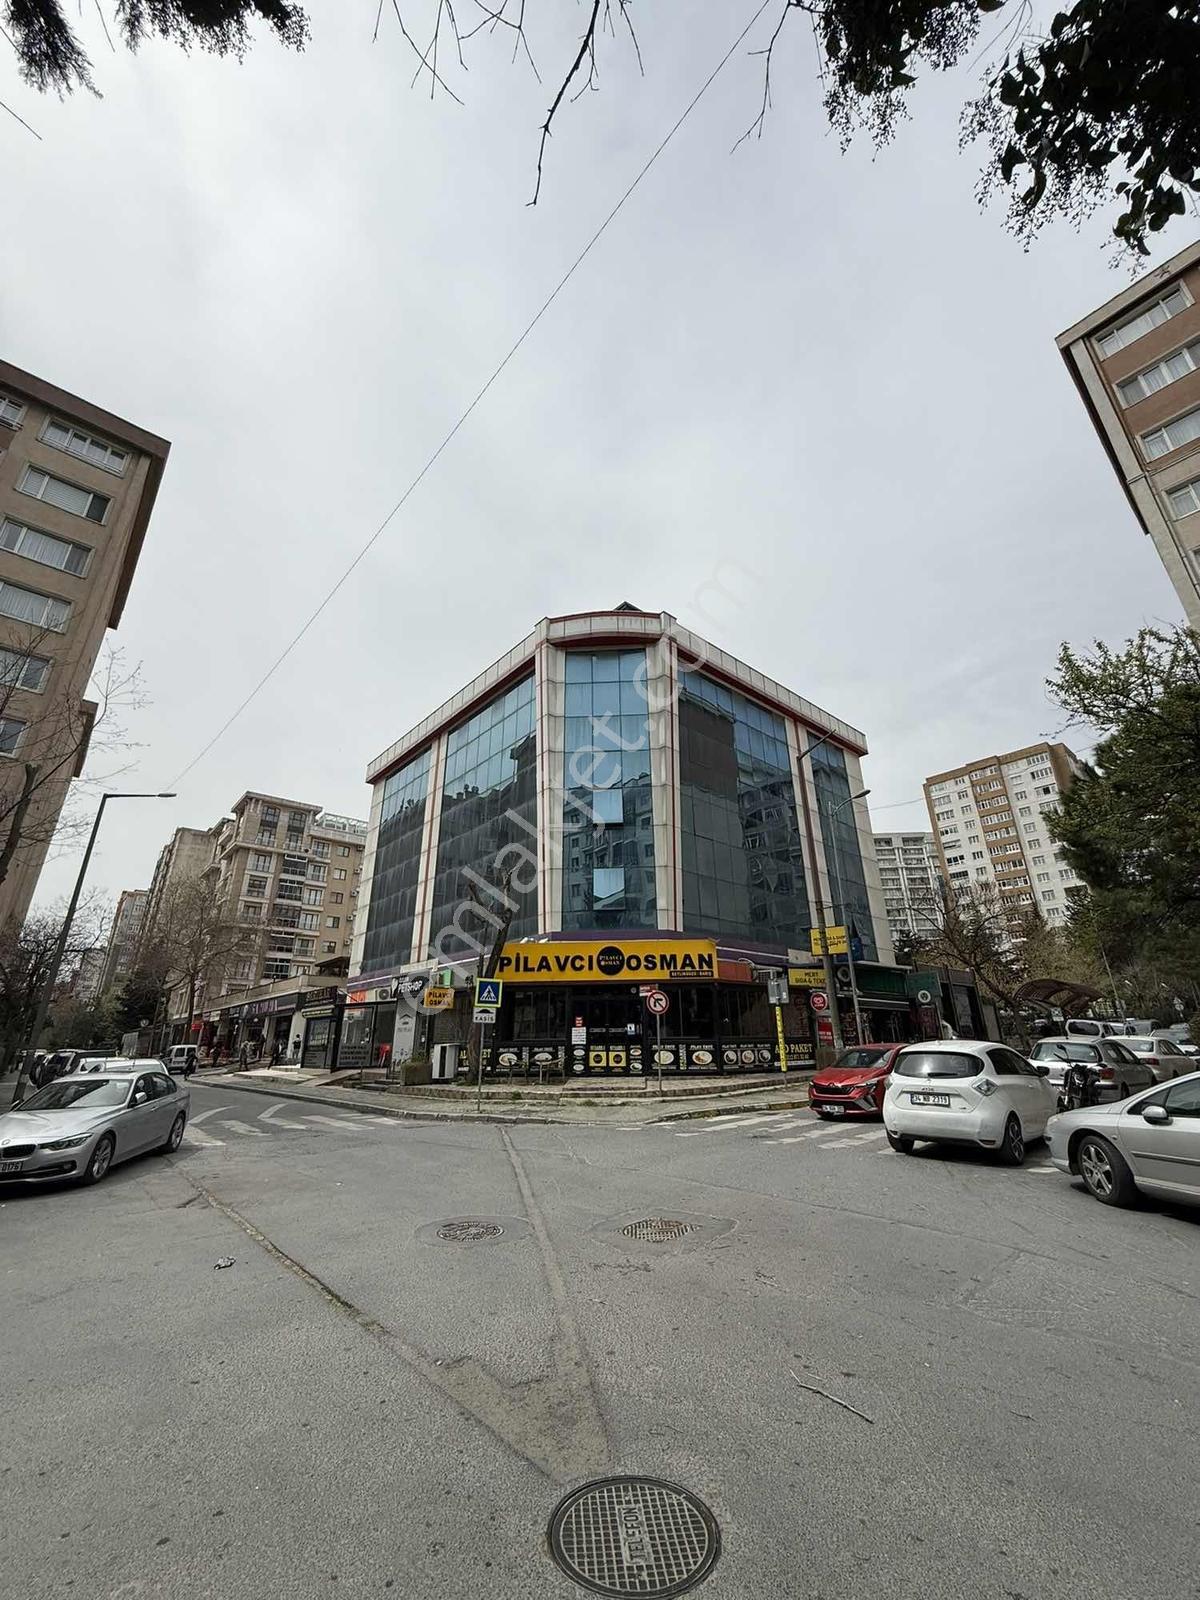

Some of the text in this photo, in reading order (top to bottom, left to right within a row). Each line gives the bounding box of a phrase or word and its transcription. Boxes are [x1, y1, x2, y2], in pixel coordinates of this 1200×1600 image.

[498, 952, 714, 973] PİLAVCI OSMAN
[790, 1043, 812, 1053] PAKET
[623, 1506, 646, 1562] TELEFON
